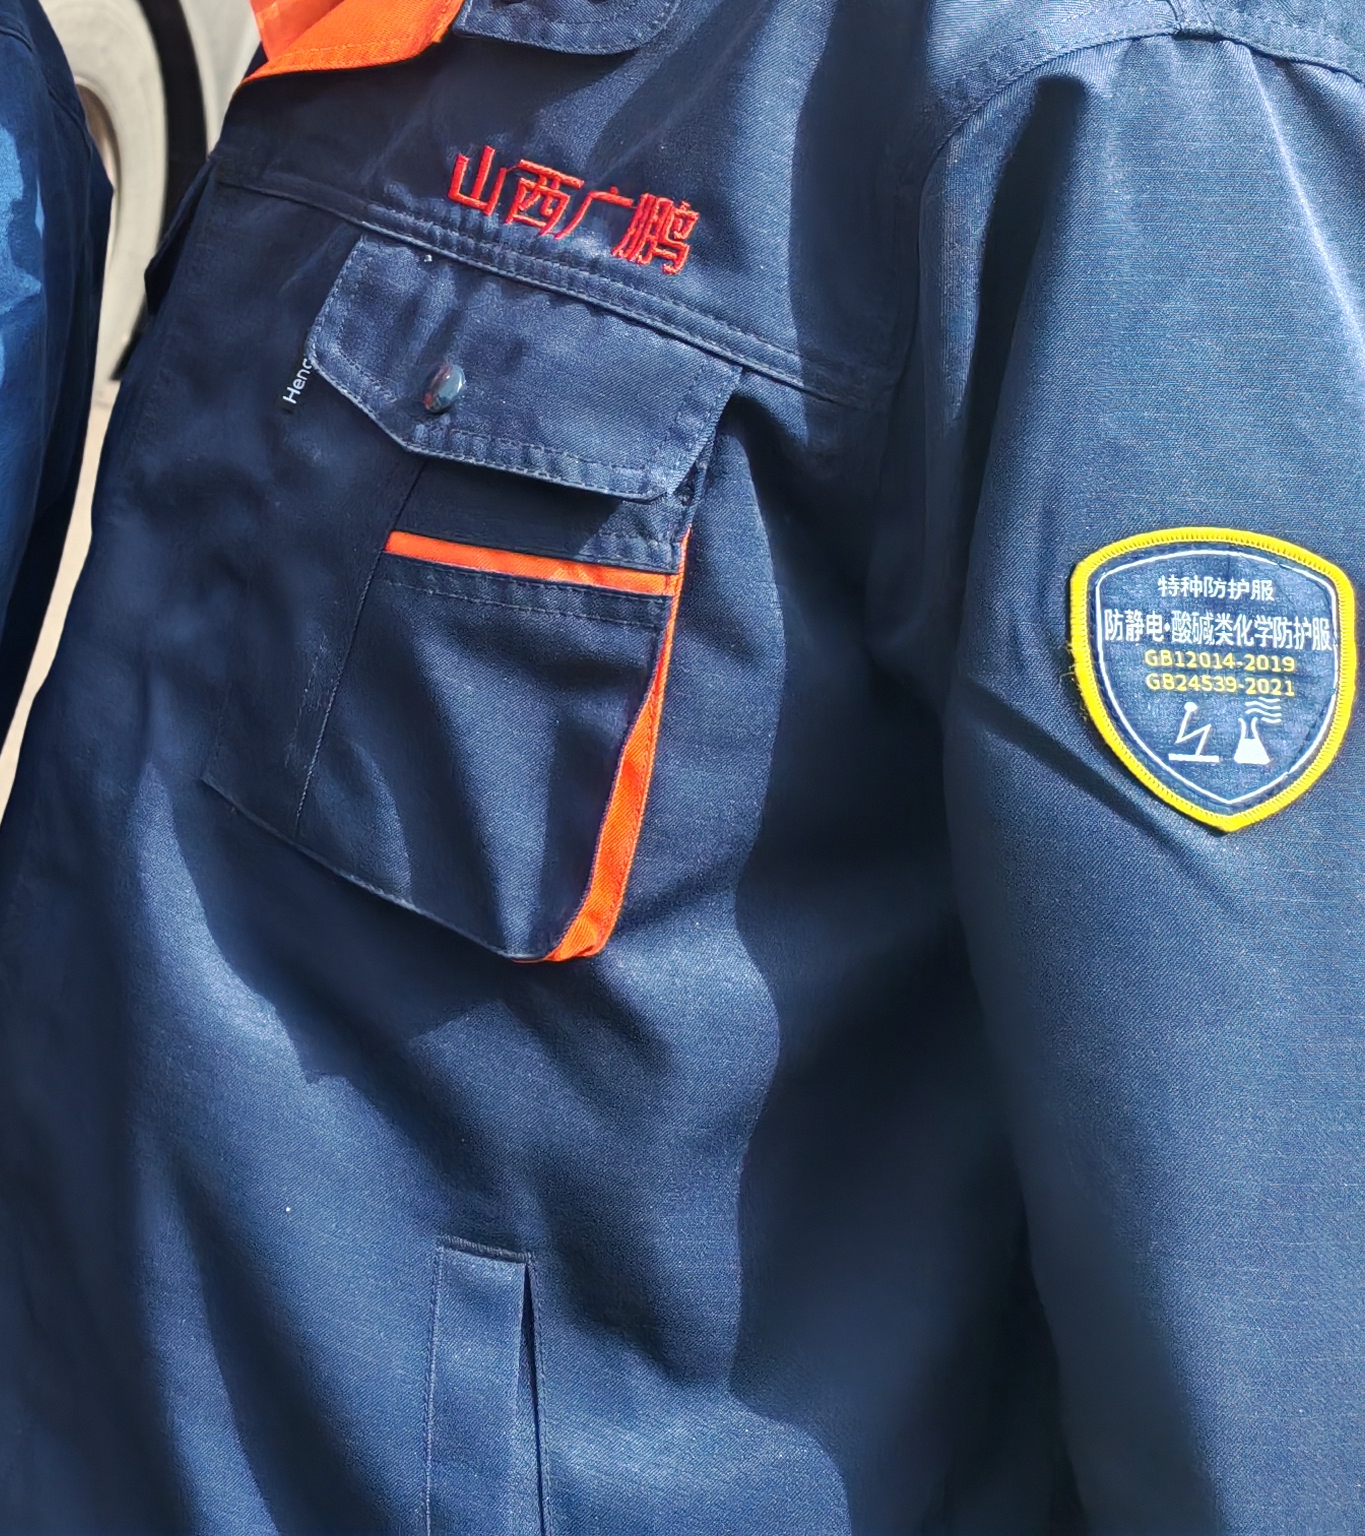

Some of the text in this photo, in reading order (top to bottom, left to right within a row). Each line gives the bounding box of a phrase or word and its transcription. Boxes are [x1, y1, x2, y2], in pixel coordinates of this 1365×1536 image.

[447, 145, 700, 275] 山西广鹏
[1157, 575, 1275, 601] 特种防护服
[1144, 649, 1296, 673] GB12014-2019
[1145, 673, 1296, 697] GB24539-2021
